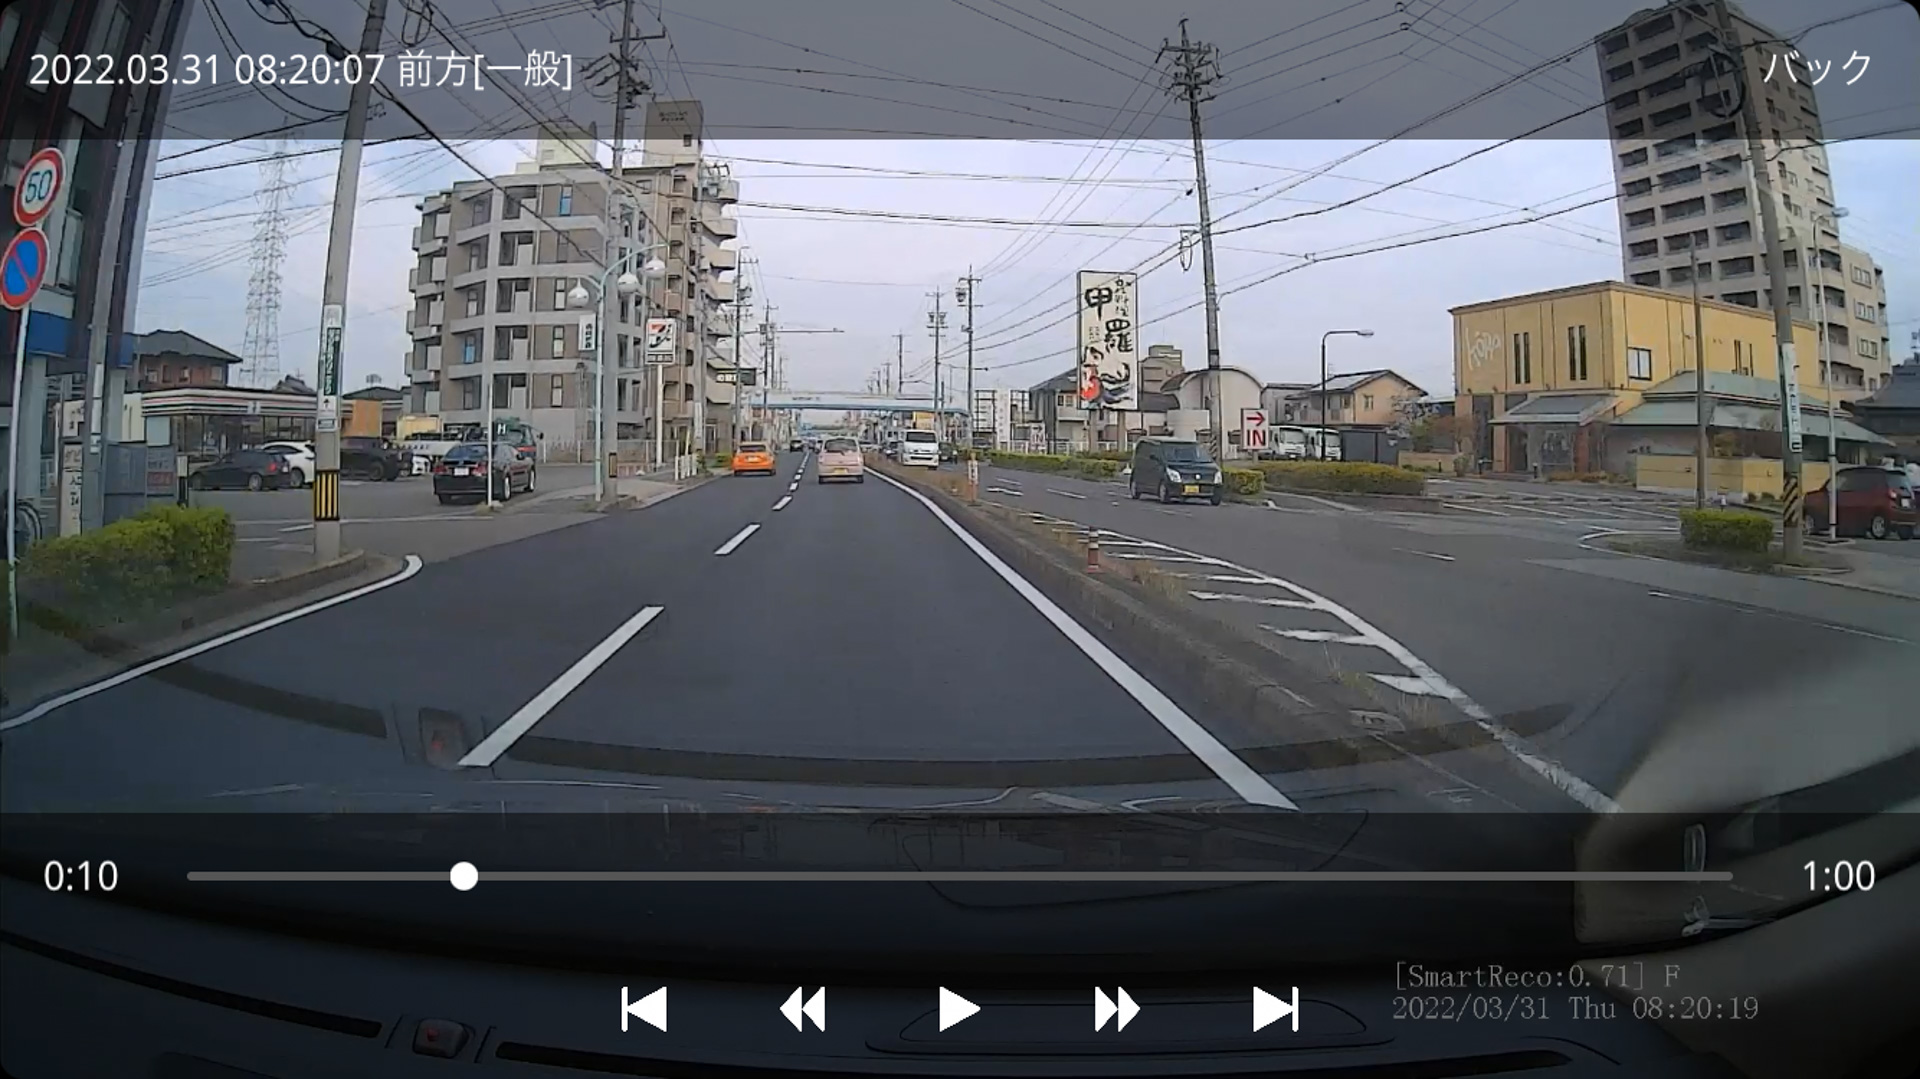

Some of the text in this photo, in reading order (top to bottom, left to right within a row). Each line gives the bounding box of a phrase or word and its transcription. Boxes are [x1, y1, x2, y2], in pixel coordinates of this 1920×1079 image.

[26, 168, 53, 203] 50
[1084, 287, 1134, 354] 甲羅
[1247, 430, 1266, 447] IN
